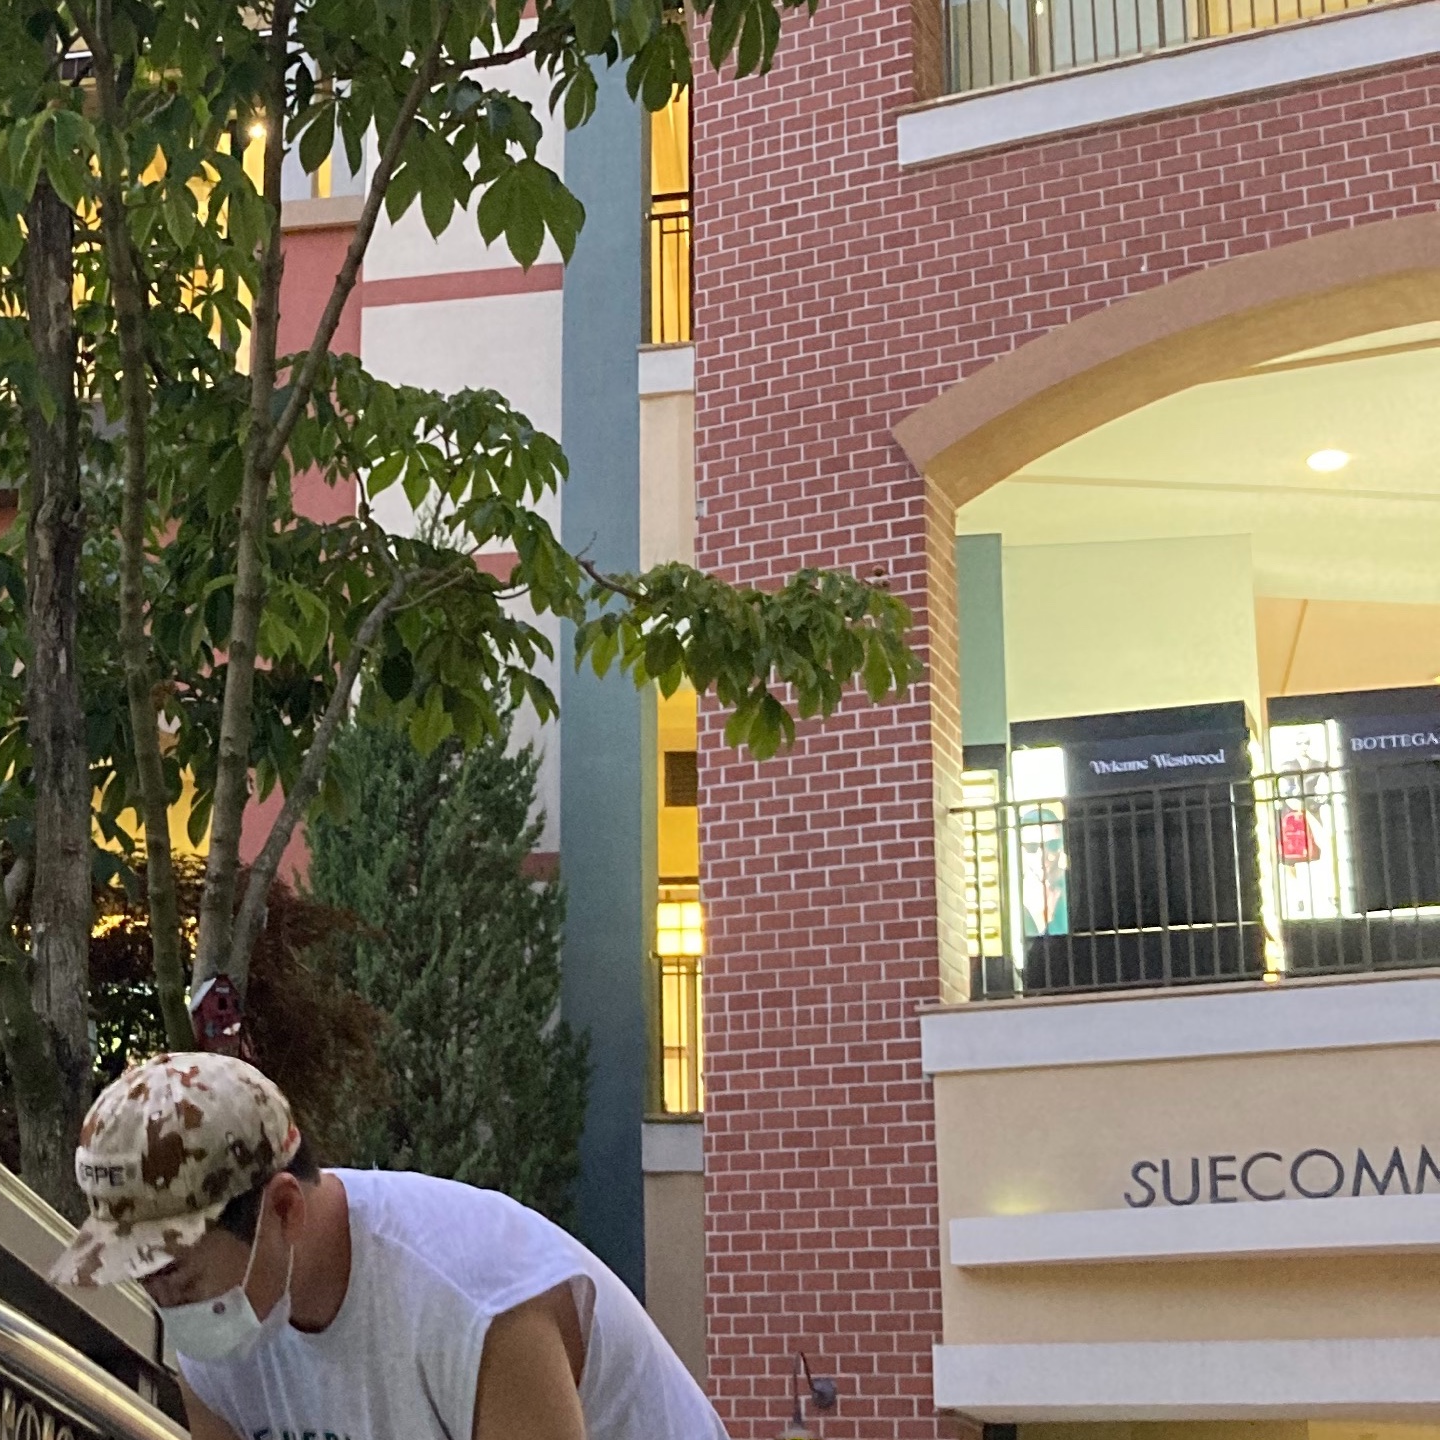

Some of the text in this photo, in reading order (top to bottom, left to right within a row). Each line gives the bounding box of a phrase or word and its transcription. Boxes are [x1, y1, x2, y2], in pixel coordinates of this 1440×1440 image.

[1350, 732, 1439, 752] BOTTEGA
[1089, 749, 1226, 775] Vivienne Westwood
